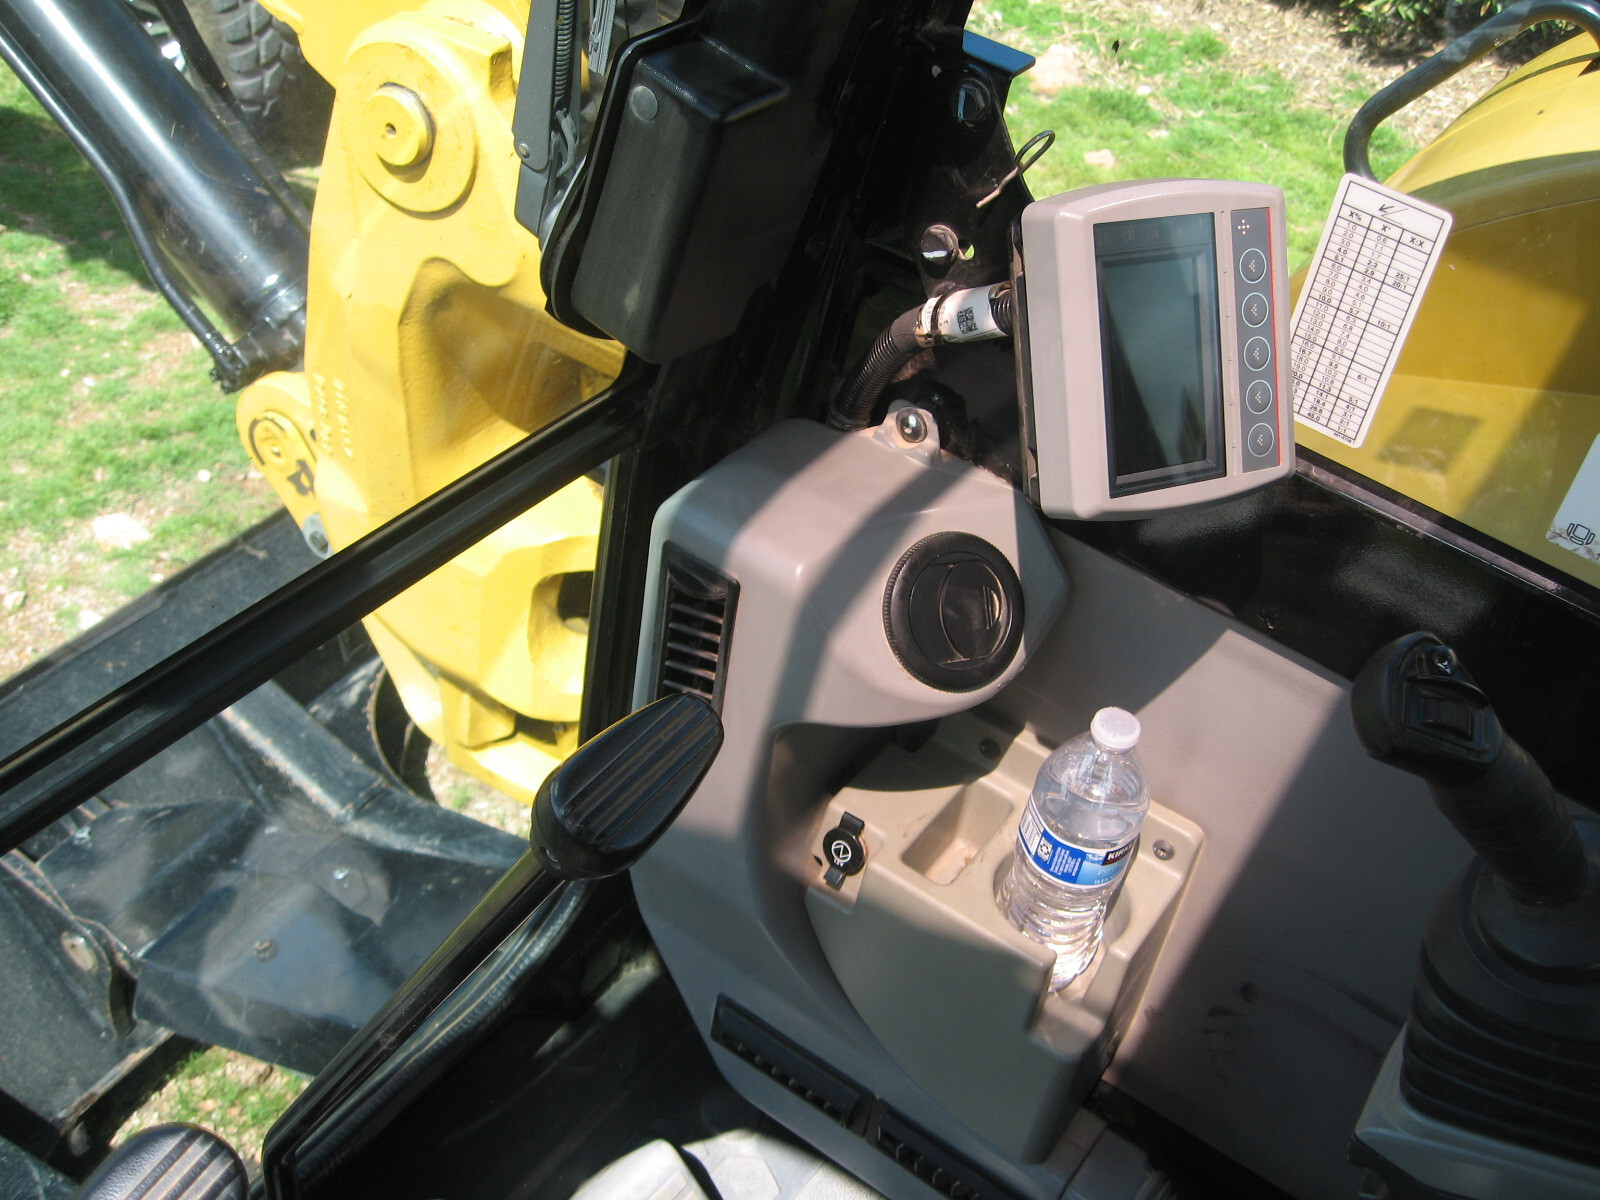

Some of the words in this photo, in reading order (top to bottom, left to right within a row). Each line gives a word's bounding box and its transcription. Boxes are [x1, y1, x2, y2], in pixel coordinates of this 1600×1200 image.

[1349, 211, 1362, 221] X%
[1409, 237, 1424, 247] X:X
[1367, 260, 1378, 268] 2.3
[1396, 272, 1410, 282] 25:1
[1325, 279, 1335, 287] 8.0
[1328, 271, 1338, 279] 7.0
[1358, 284, 1368, 292] 4.0
[1392, 281, 1407, 290] 20:1
[1316, 302, 1328, 311] 11.0
[1313, 310, 1325, 319] 12.0
[1318, 294, 1331, 303] 10.0
[1377, 320, 1391, 330] 10:1
[1307, 325, 1320, 334] 14.0
[1310, 318, 1322, 326] 13.0
[1340, 331, 1350, 339] 7.4
[1304, 333, 1316, 342] 15.0
[1301, 340, 1314, 349] 16.0
[1298, 348, 1311, 356] 16.7
[1296, 355, 1308, 364] 18.0
[1325, 368, 1337, 377] 10.2
[1293, 362, 1305, 371] 19.0
[1322, 376, 1334, 384] 10.8
[1318, 383, 1331, 392] 11.3
[1316, 391, 1328, 399] 14.1
[1313, 398, 1326, 407] 18.4
